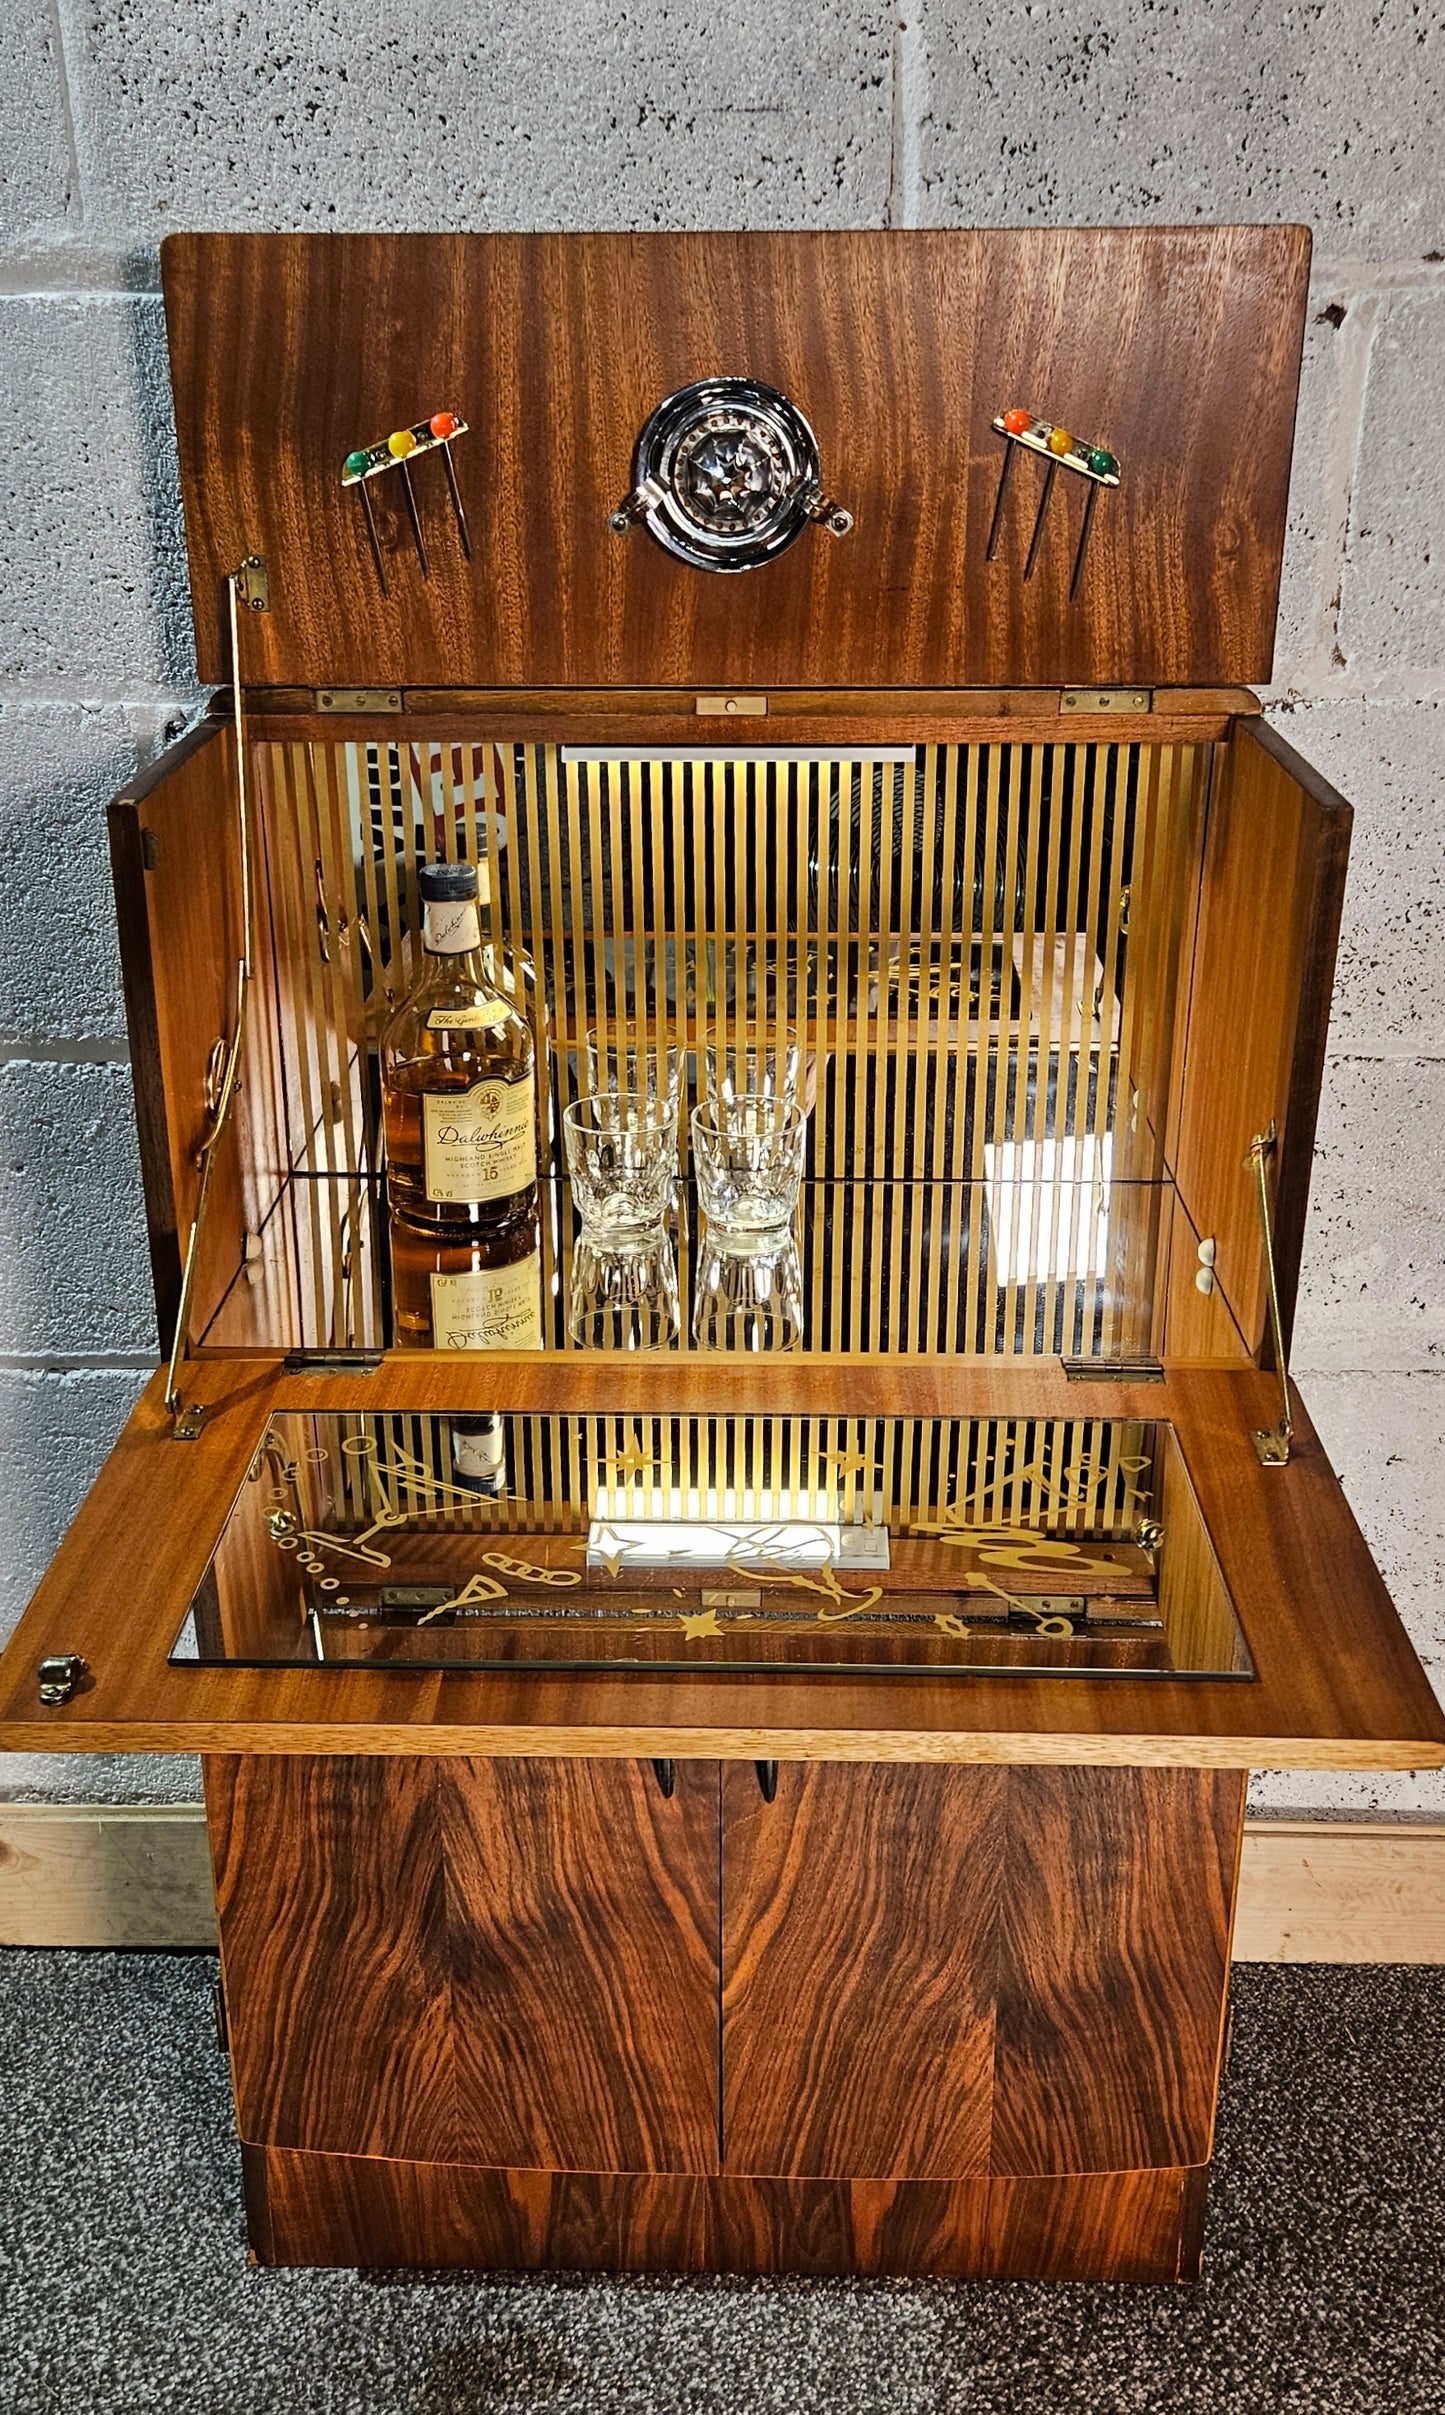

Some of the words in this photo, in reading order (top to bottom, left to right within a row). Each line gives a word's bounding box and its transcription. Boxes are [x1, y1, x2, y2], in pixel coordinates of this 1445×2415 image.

[436, 1117, 530, 1150] Dalwhinnie
[445, 1154, 486, 1162] HIGHLAND
[488, 1149, 511, 1160] SINGLE
[460, 1160, 491, 1169] SCOTCH
[482, 1165, 499, 1181] 15
